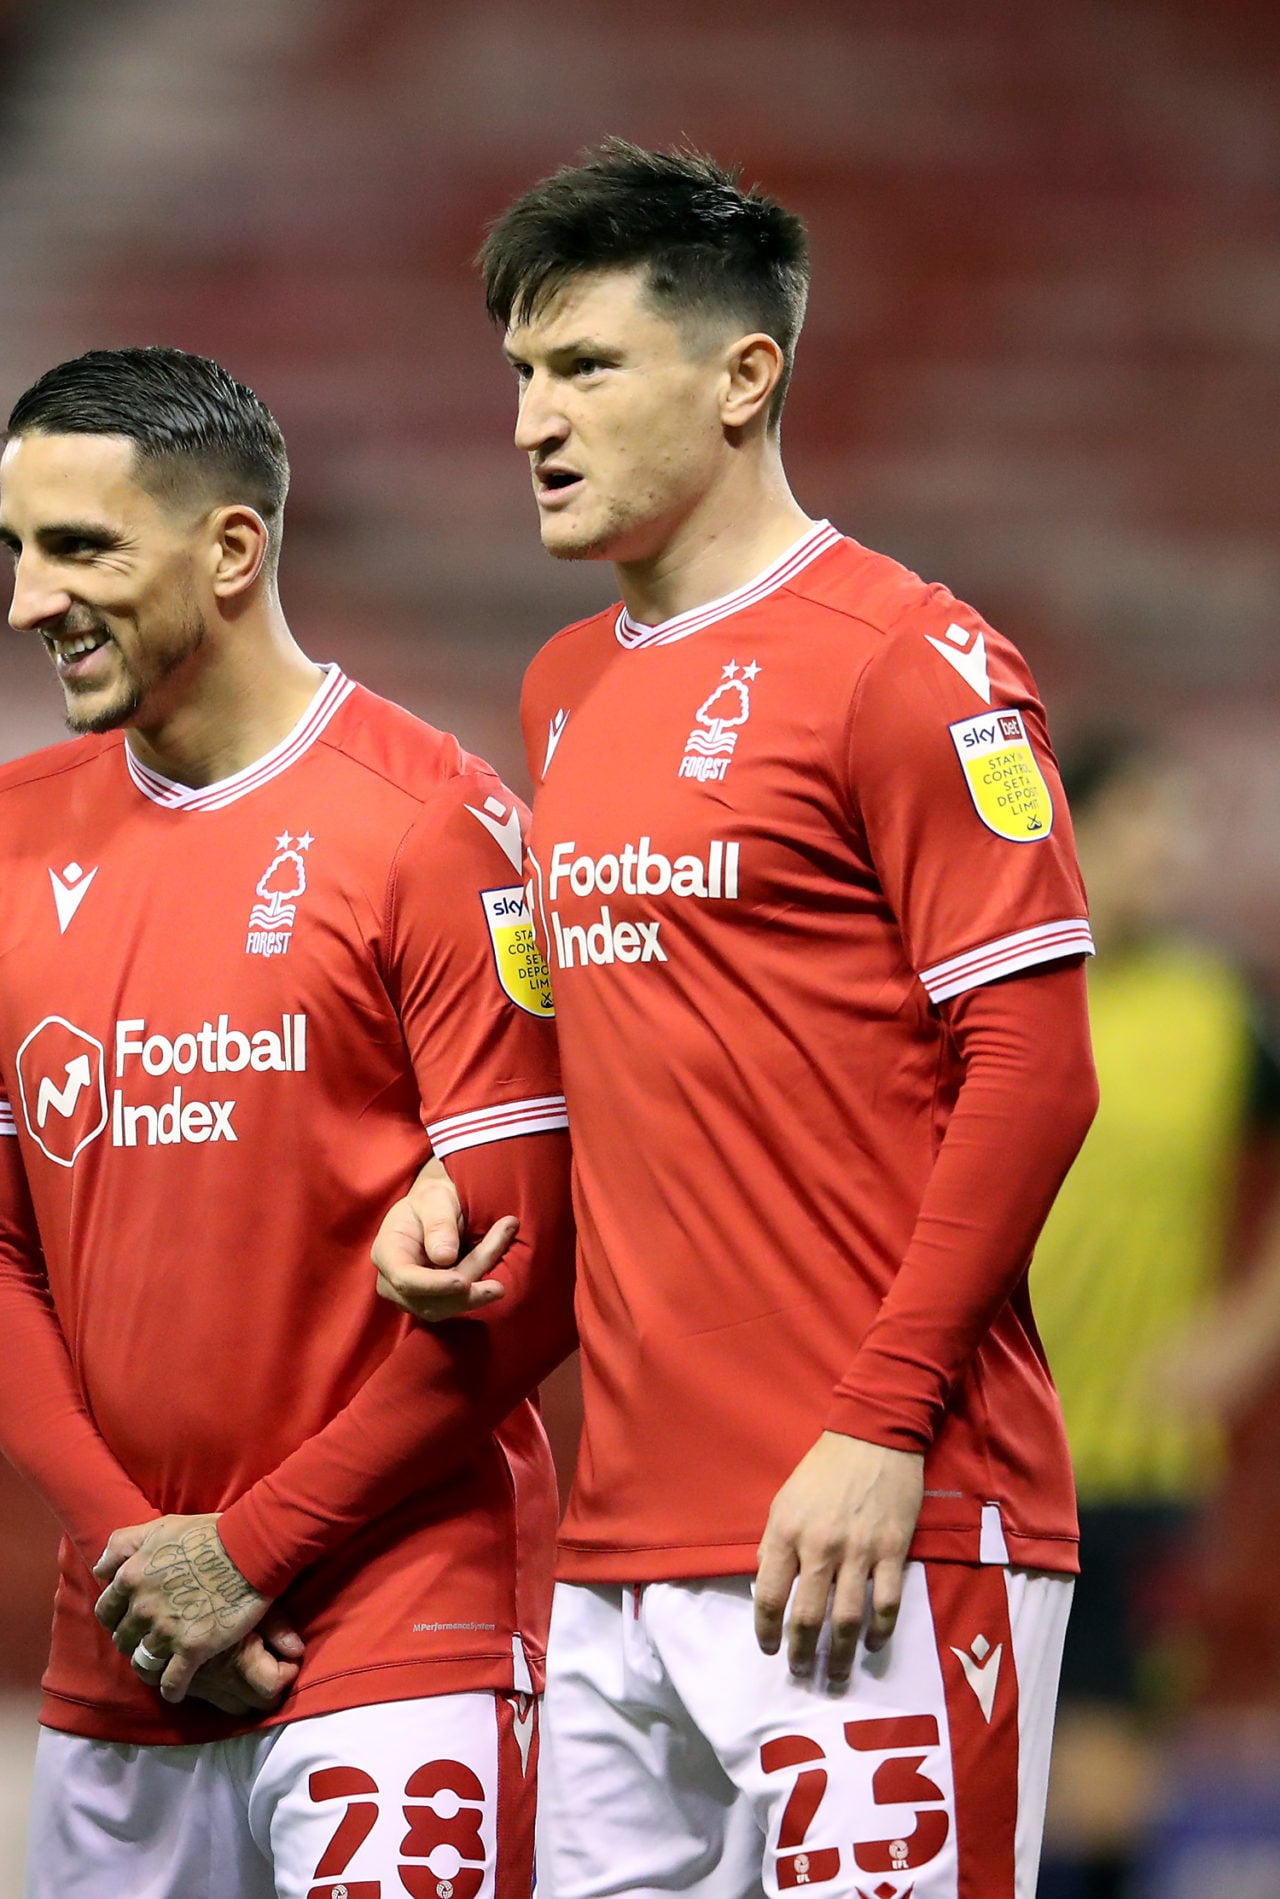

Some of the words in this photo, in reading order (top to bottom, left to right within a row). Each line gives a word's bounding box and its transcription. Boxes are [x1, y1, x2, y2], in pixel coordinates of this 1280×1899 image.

[963, 726, 995, 748] sky
[1000, 719, 1020, 736] bet
[988, 752, 1016, 770] STAY
[1003, 776, 1024, 791] SET
[549, 836, 740, 900] Football
[493, 897, 523, 917] sky
[514, 930, 533, 941] STA
[550, 905, 668, 968] Index
[518, 965, 549, 979] DEPO
[530, 978, 549, 990] LIM
[115, 1013, 307, 1077] Football
[111, 1086, 238, 1147] Index
[760, 1714, 949, 1890] 23
[307, 1759, 486, 1899] 28
